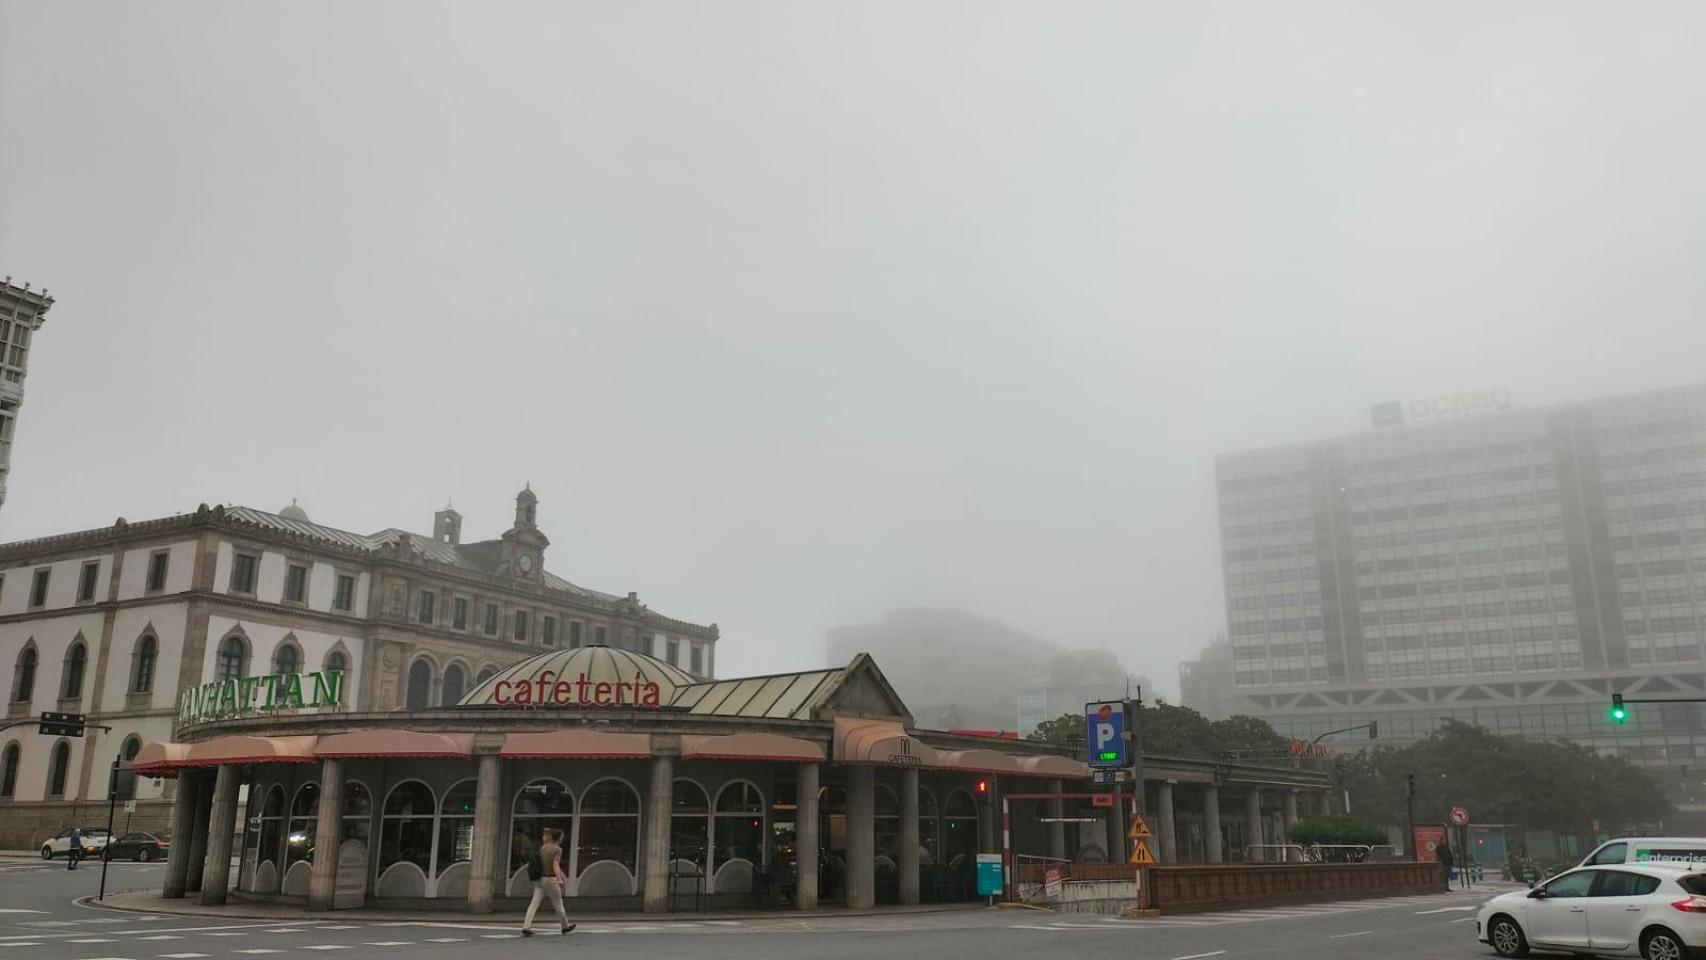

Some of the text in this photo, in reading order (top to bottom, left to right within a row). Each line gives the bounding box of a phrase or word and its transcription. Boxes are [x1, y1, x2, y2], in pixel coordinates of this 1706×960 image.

[179, 670, 344, 721] ANHATTAN
[494, 671, 661, 706] cafeteria
[1097, 723, 1115, 749] P
[888, 753, 921, 764] CAFETERIA
